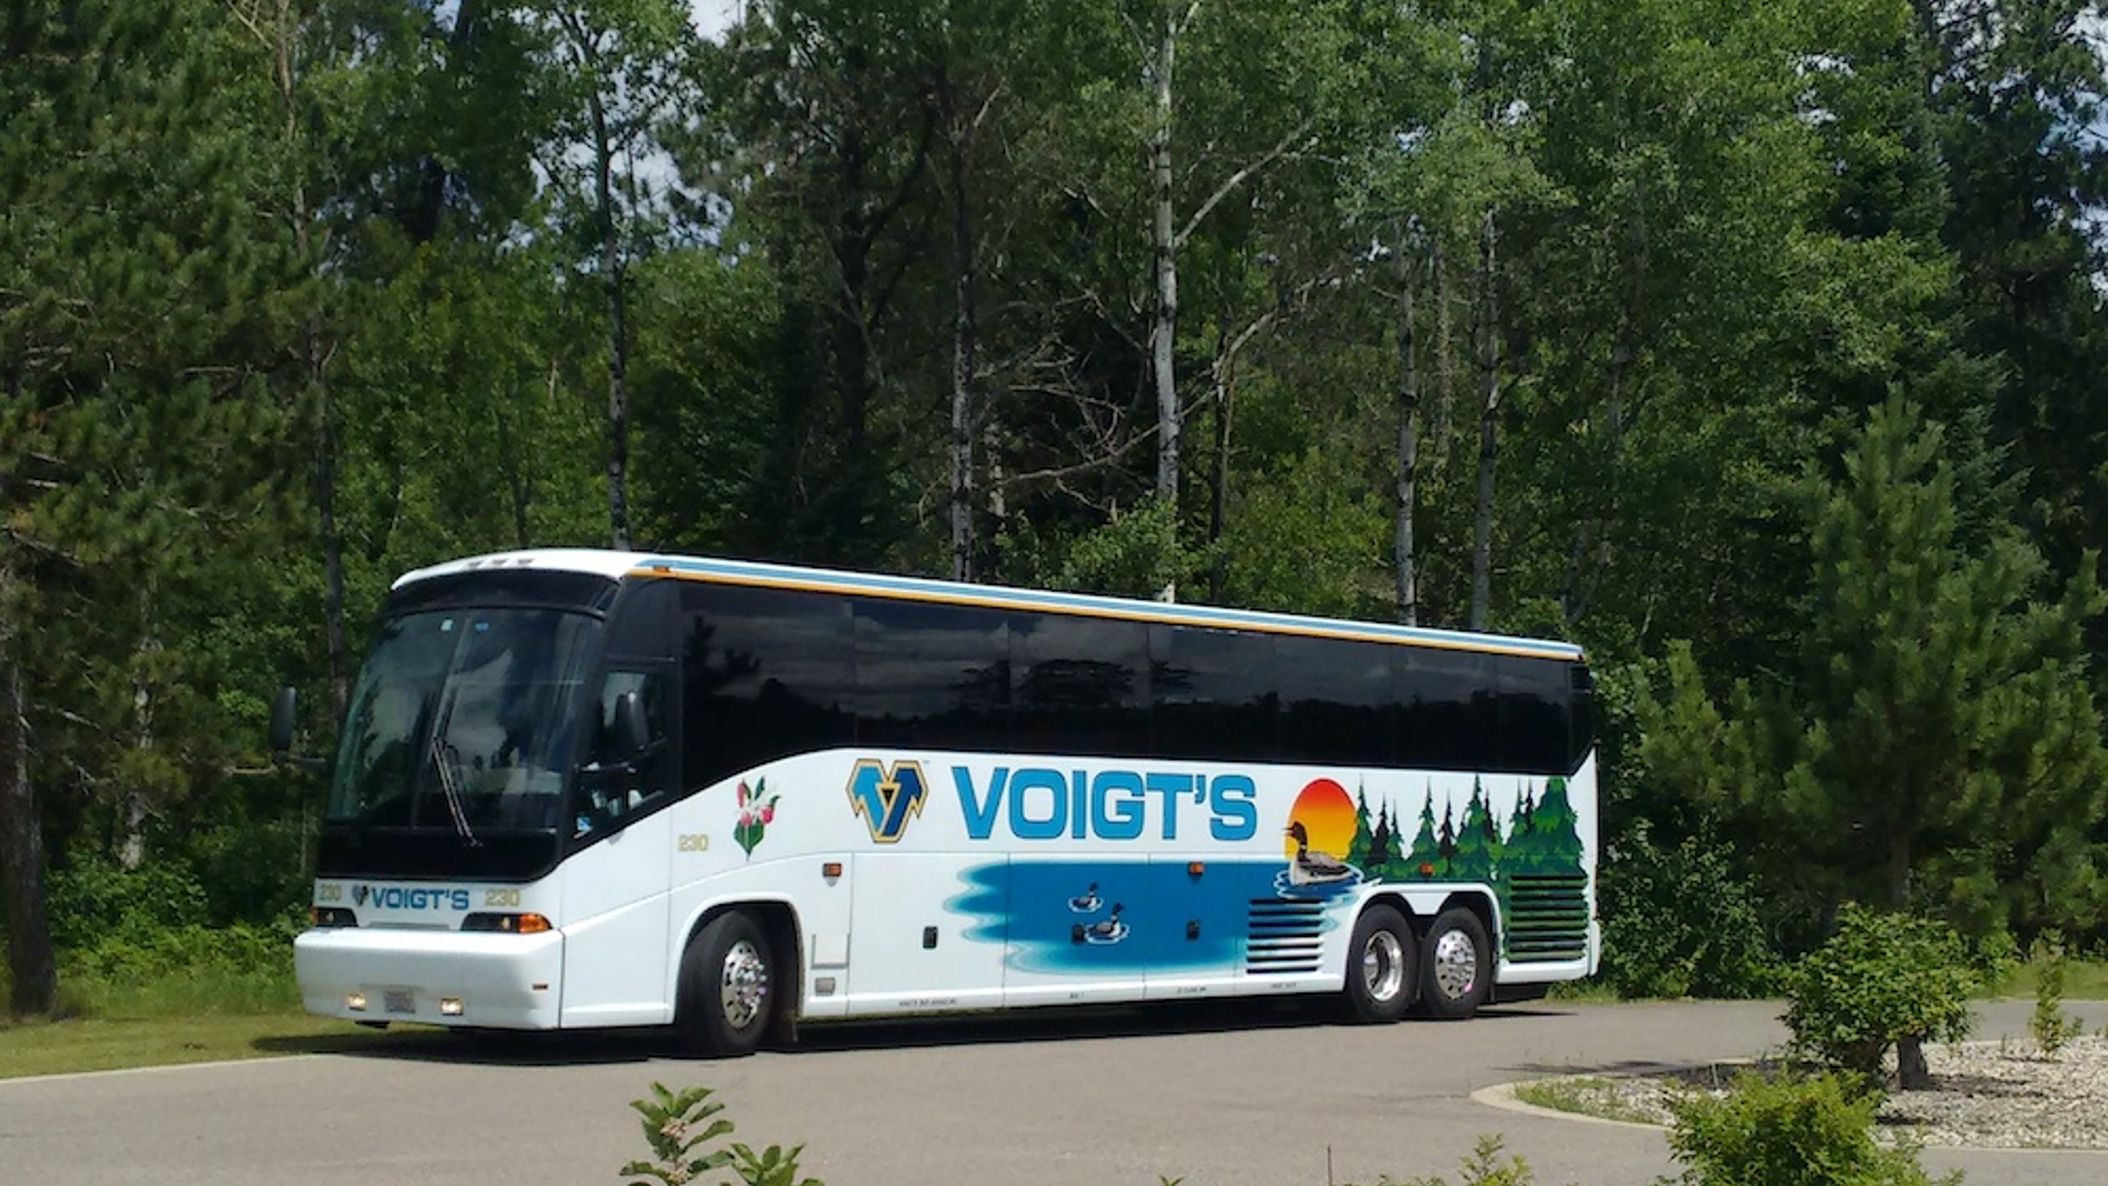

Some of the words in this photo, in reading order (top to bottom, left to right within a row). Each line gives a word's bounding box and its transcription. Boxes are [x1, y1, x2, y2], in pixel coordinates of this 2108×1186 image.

[950, 766, 1257, 841] VOIGT'S
[678, 833, 709, 852] 230
[319, 884, 342, 902] 230
[371, 887, 469, 910] VOIGT'S
[484, 888, 520, 907] 230
